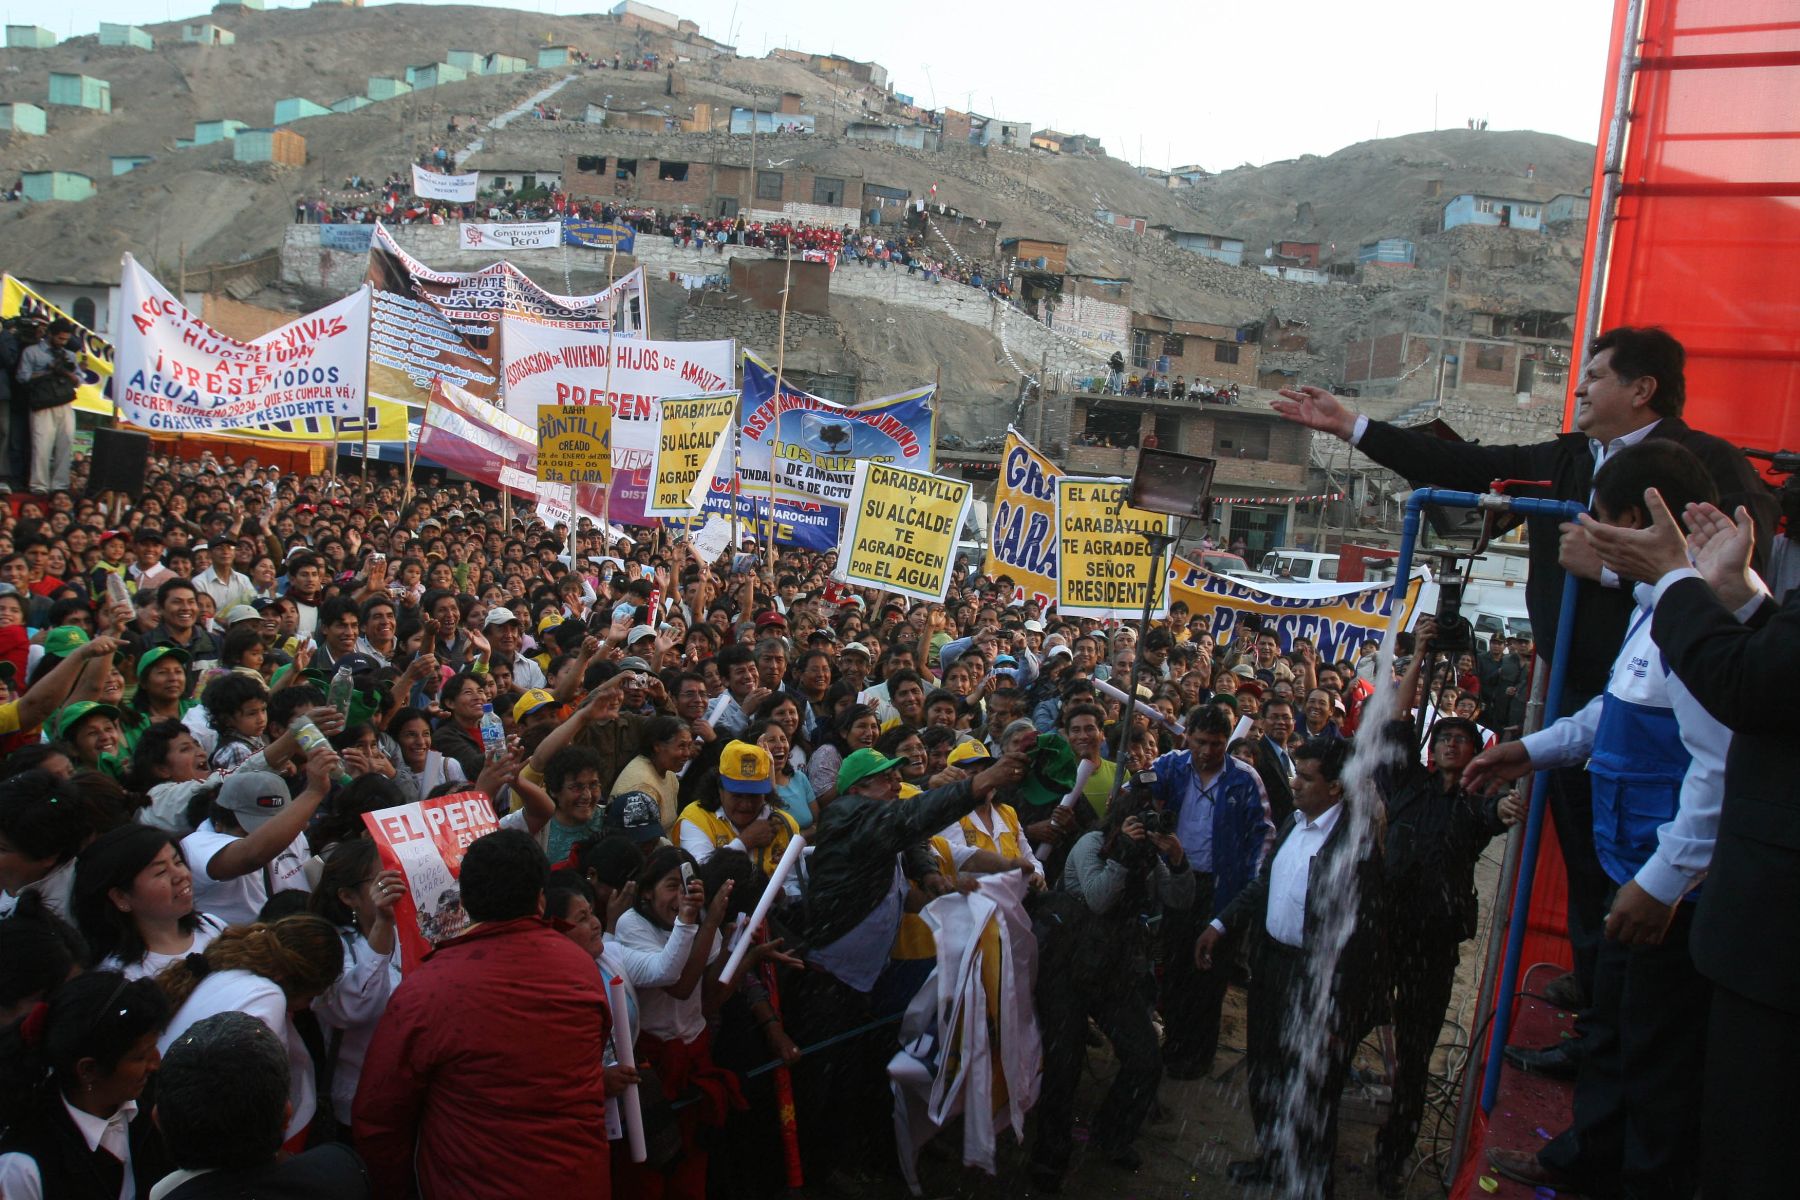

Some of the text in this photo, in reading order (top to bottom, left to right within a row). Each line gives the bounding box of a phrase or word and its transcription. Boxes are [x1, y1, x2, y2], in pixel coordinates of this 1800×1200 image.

[494, 228, 555, 237] Construyendo
[511, 237, 539, 246] Perú
[460, 277, 476, 289] DE
[481, 277, 506, 289] ATE
[443, 308, 499, 320] UEBLOS
[476, 299, 518, 310] PARA
[244, 352, 262, 364] DE
[215, 359, 269, 378] ATE
[552, 354, 561, 366] DE
[560, 344, 610, 369] VIVIENDA
[616, 346, 660, 372] HIJOS
[663, 355, 676, 371] DE
[680, 360, 727, 392] AMAUTA
[130, 369, 200, 406] AGUA
[263, 390, 282, 408] QUE
[283, 388, 297, 402] SE
[296, 386, 332, 401] CUMPLA
[556, 382, 660, 421] PRESEN
[662, 400, 733, 421] CARABAYLLO
[149, 412, 213, 430] GRACIAS
[690, 421, 697, 430] Y
[538, 416, 610, 451] PUNTILLA
[661, 431, 721, 452] SU ALCAL
[558, 440, 590, 452] CREADO
[684, 453, 699, 467] TE
[785, 462, 804, 477] DE
[569, 469, 602, 482] CLARA
[740, 467, 781, 484] UNDAO
[783, 476, 796, 488] EL
[806, 482, 821, 495] DE
[823, 485, 852, 499] OCTU
[871, 467, 964, 504] CARABAYLLO
[1068, 487, 1121, 503] EL ALC
[660, 493, 678, 505] POR
[910, 495, 917, 505] Y
[865, 499, 953, 535] SU ALCALDE
[1064, 516, 1163, 535] CARABAYLLO
[894, 527, 915, 545] TE
[857, 537, 945, 570] AGRADECEN
[1062, 539, 1165, 558] TE AGRADEC
[851, 560, 939, 591] POR EL AGUA
[1086, 560, 1136, 579] SEÑOR
[380, 814, 425, 845] EL
[424, 793, 497, 836] PERÚ
